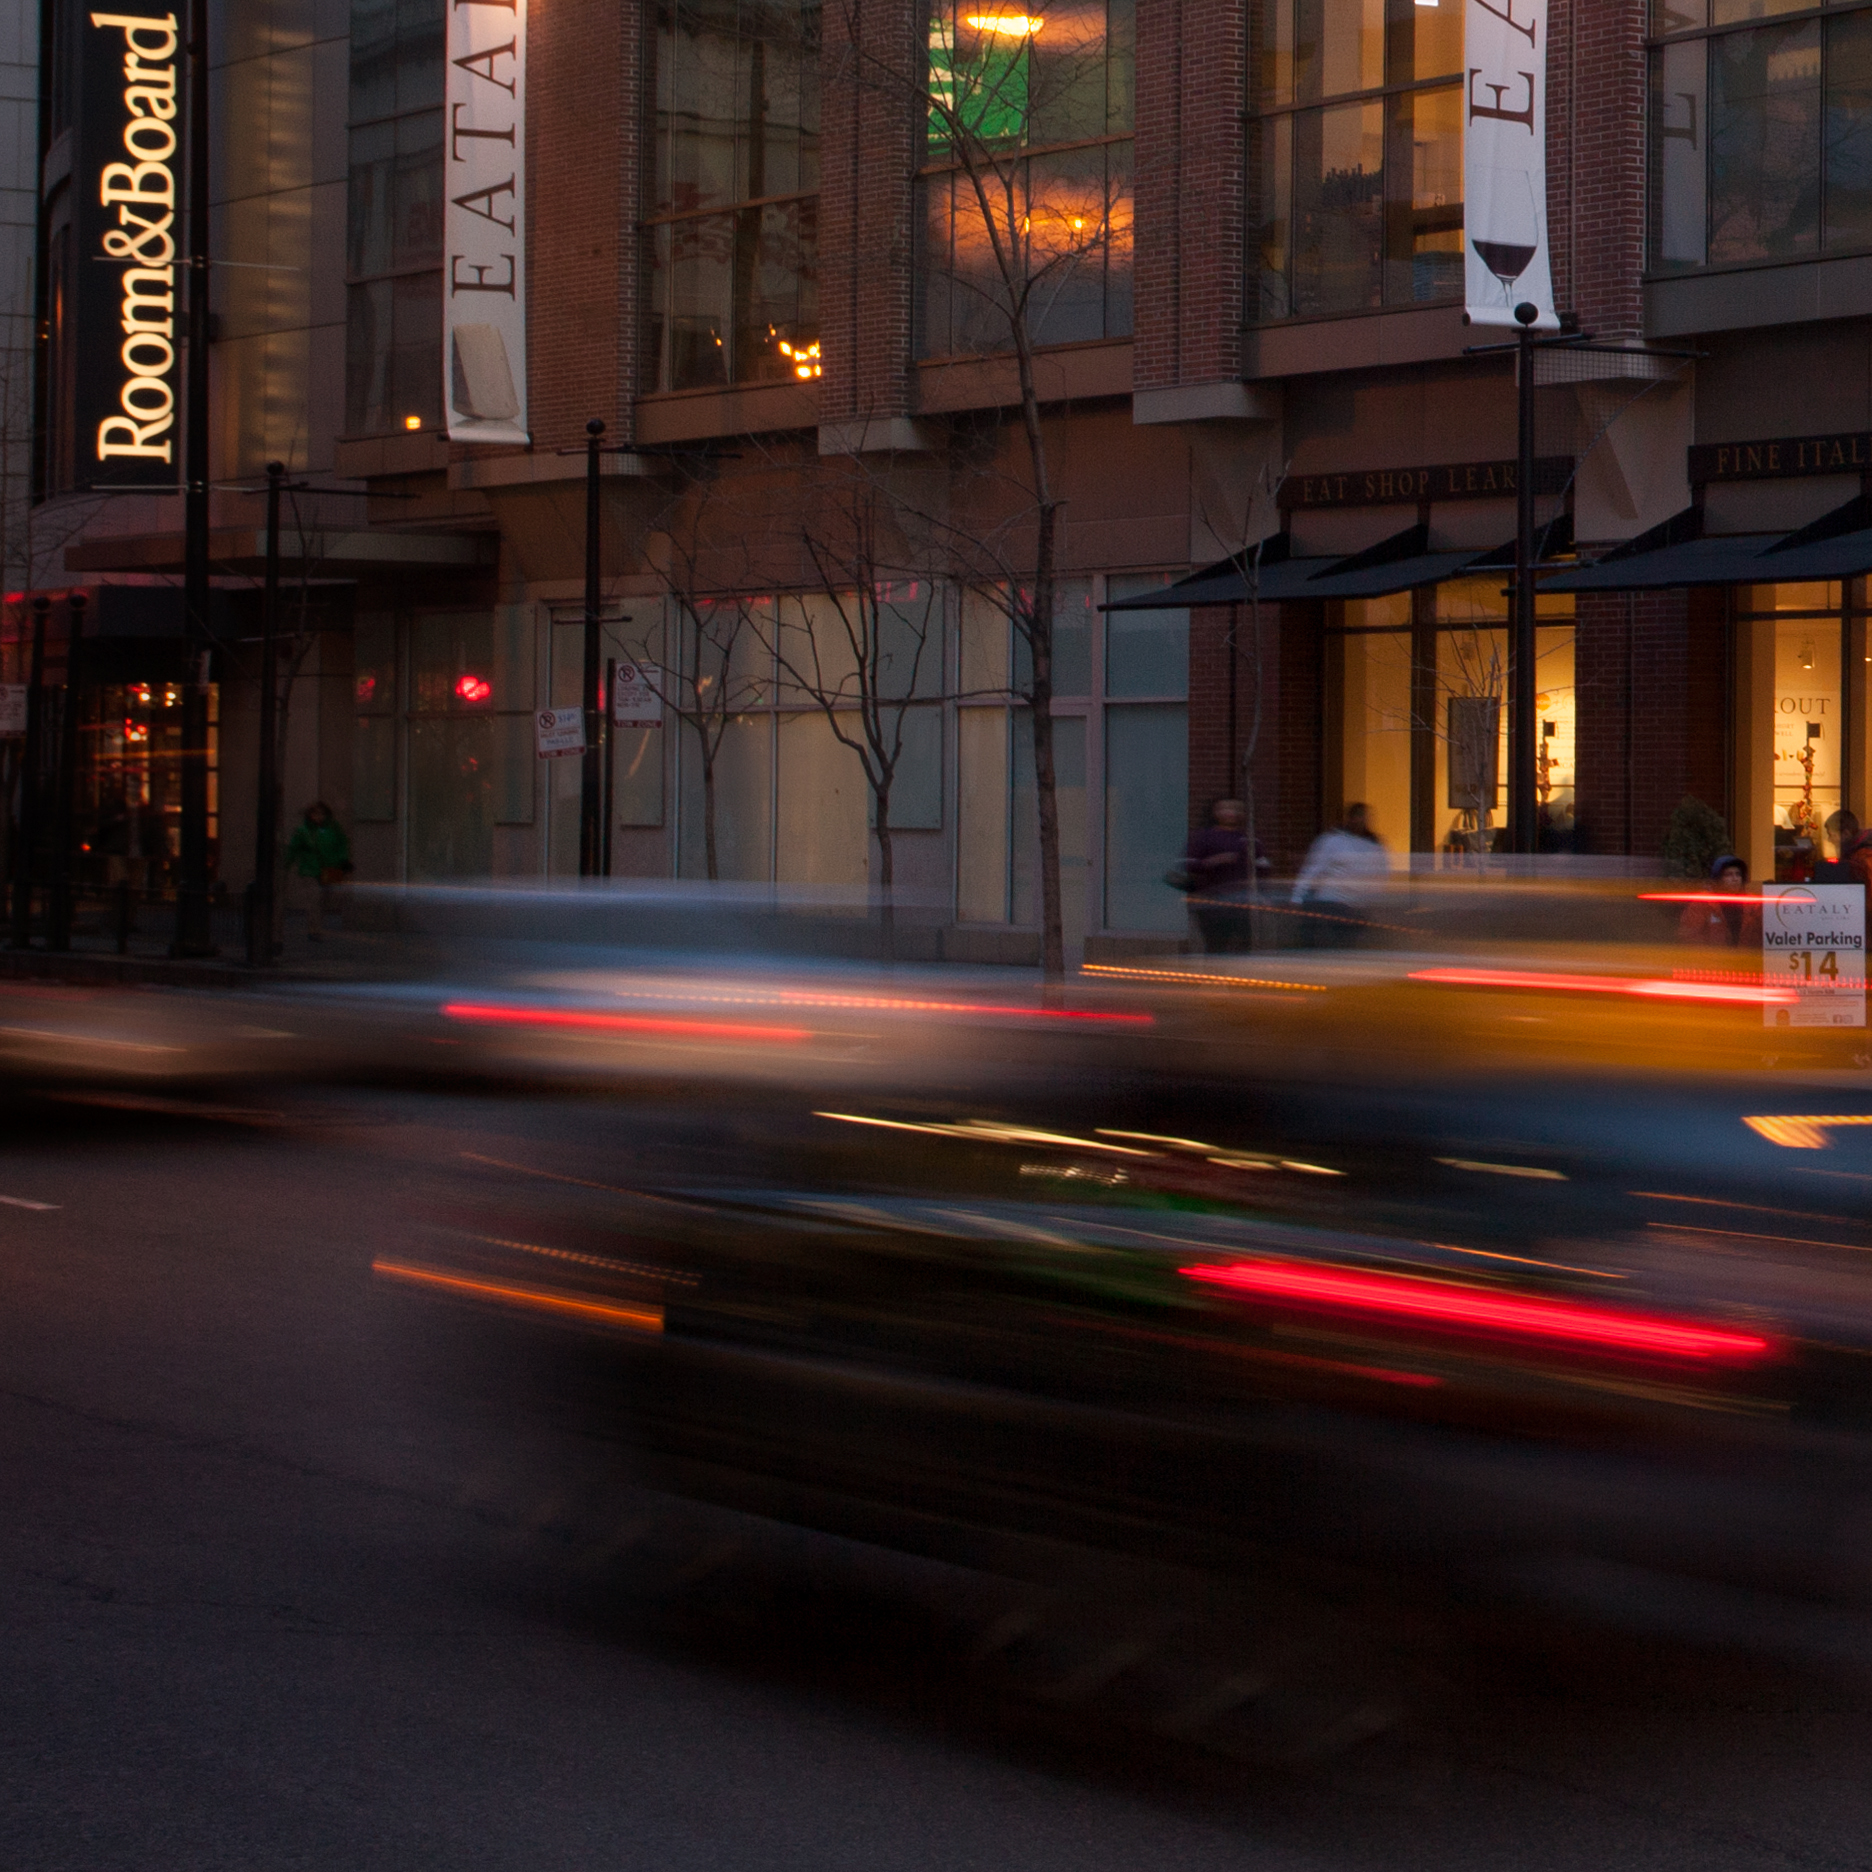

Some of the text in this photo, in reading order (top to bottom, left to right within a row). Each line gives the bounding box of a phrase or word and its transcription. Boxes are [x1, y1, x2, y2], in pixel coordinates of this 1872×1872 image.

[91, 10, 178, 464] Room&Board
[1717, 445, 1781, 474] FINE
[1303, 465, 1517, 502] EAT SHOP LEAR
[1783, 904, 1851, 915] EATALY
[1765, 931, 1862, 948] Valet Parking
[1789, 951, 1839, 982] $14
